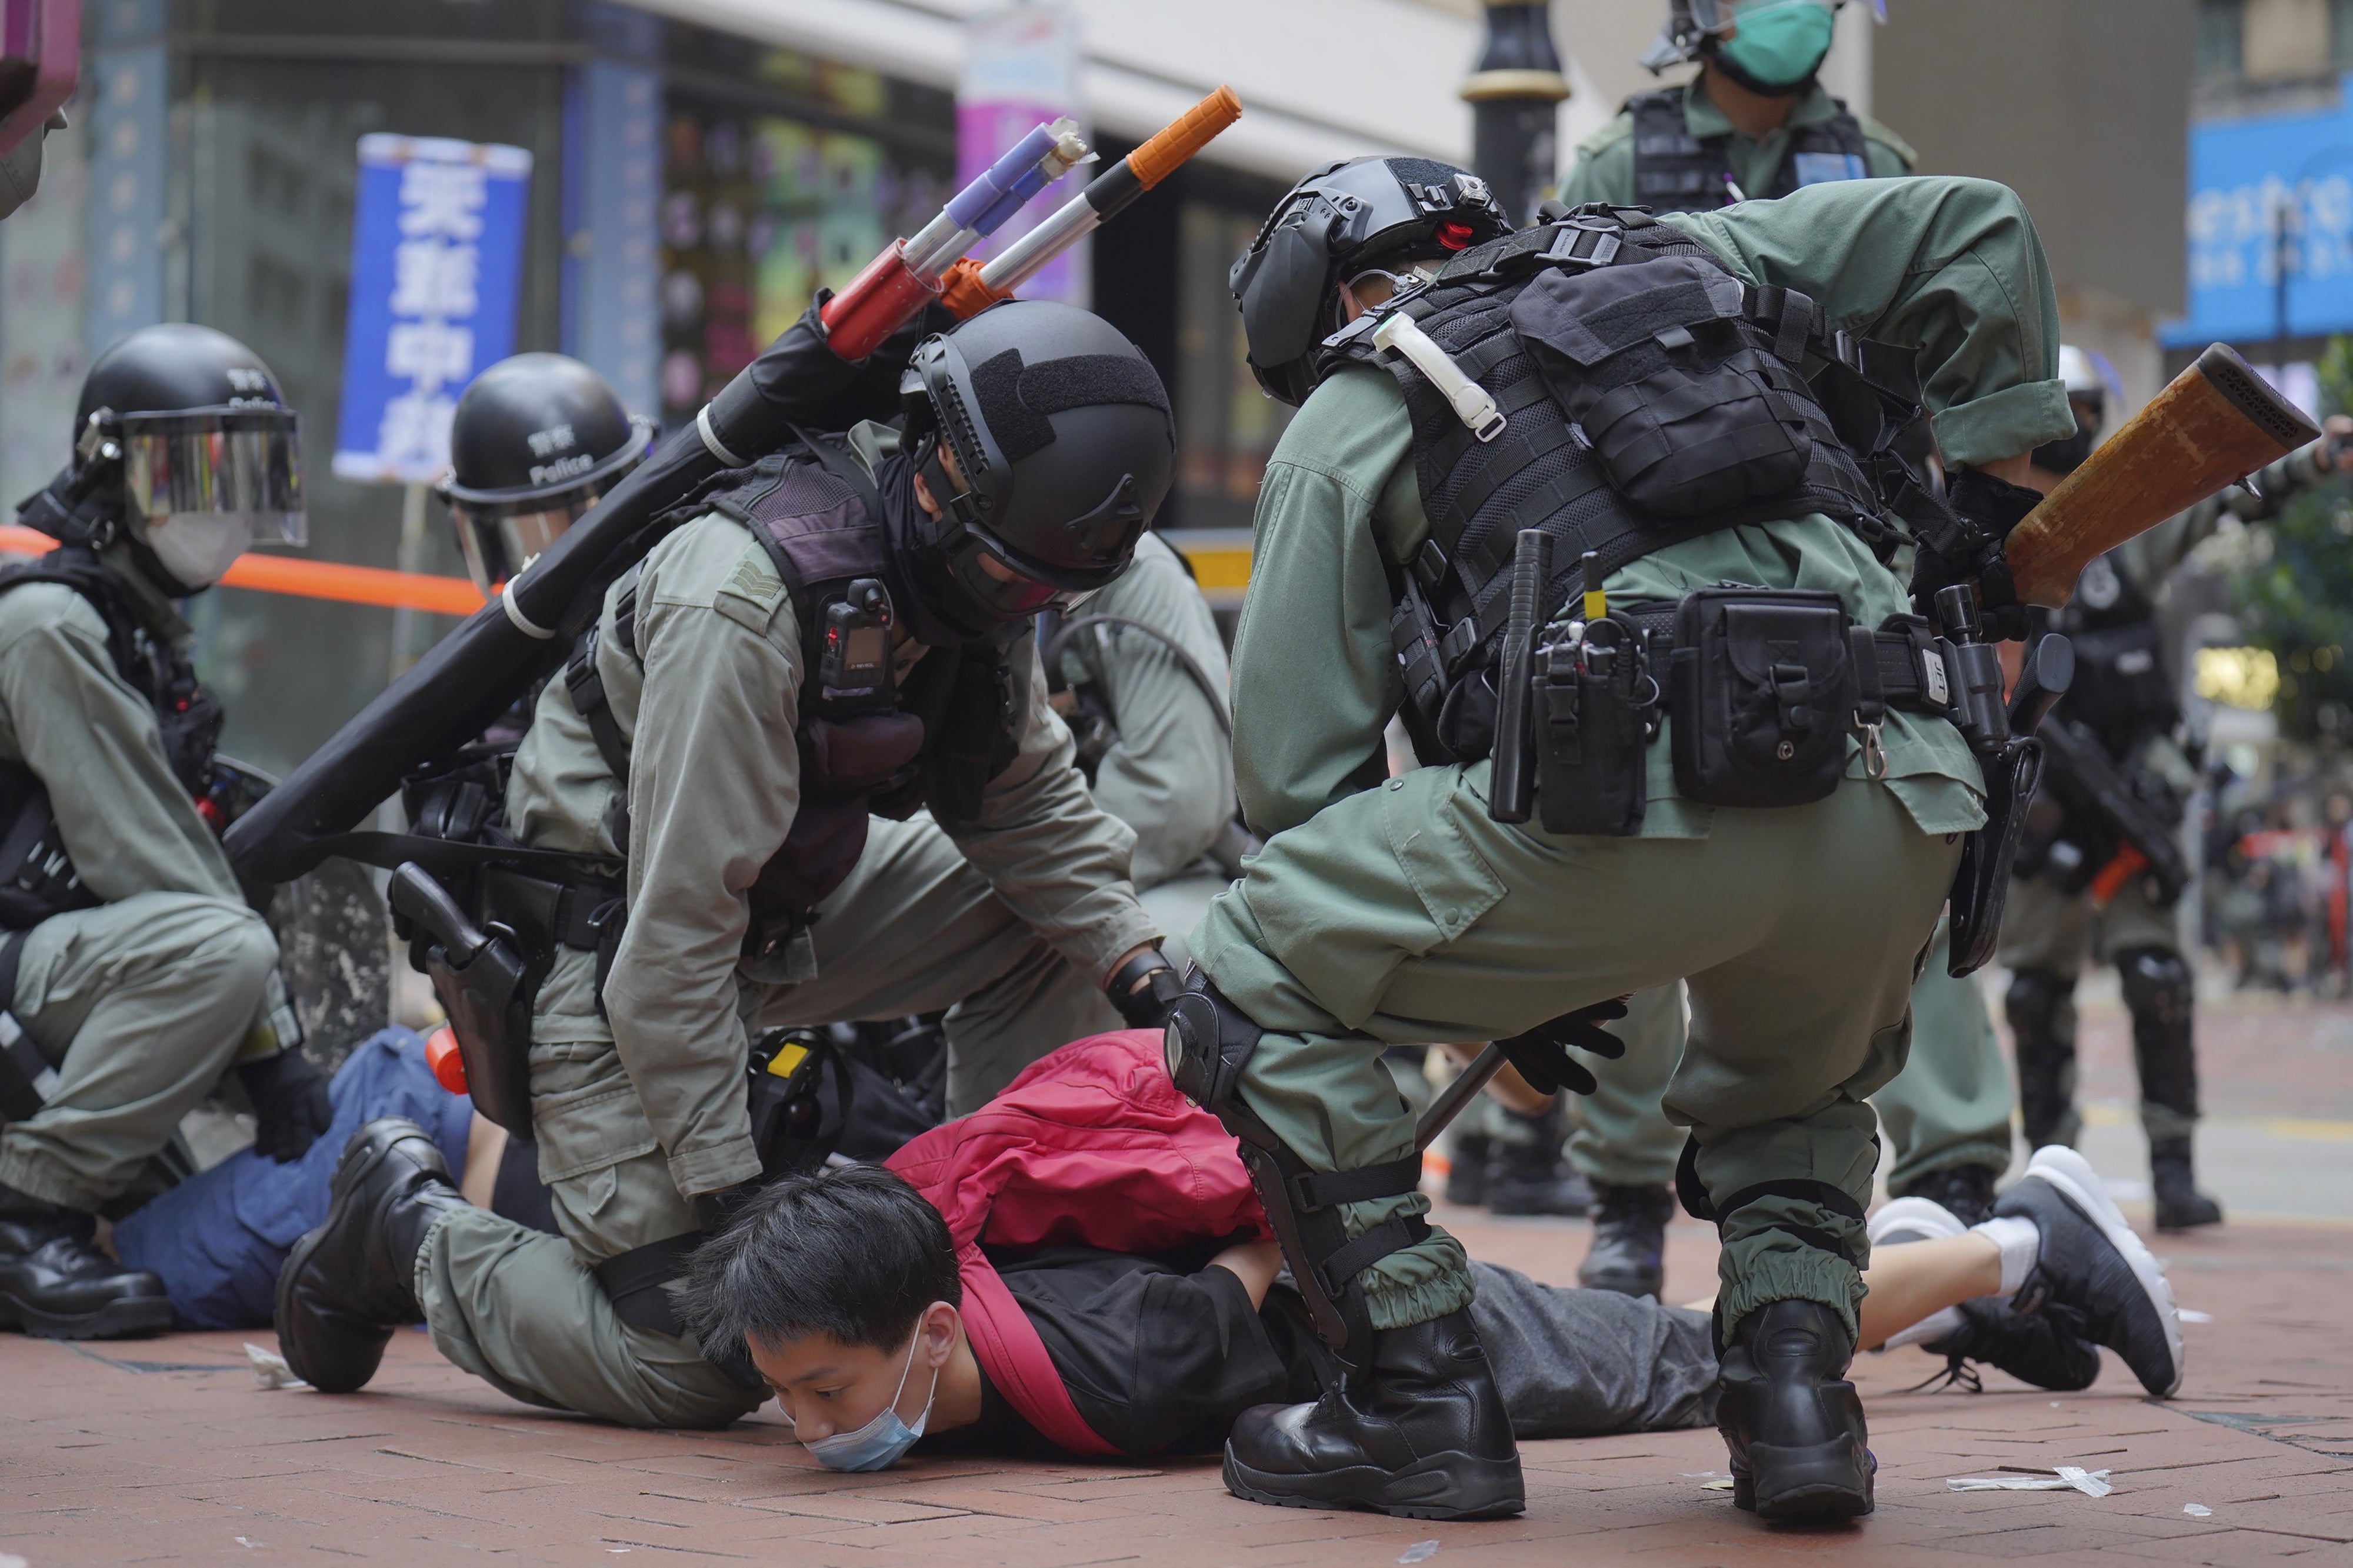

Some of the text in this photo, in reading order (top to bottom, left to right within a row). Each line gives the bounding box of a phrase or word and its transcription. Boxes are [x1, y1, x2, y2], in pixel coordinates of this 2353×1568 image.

[528, 423, 575, 458] 警察
[529, 453, 594, 487] Police
[1935, 661, 1945, 695] JFT
